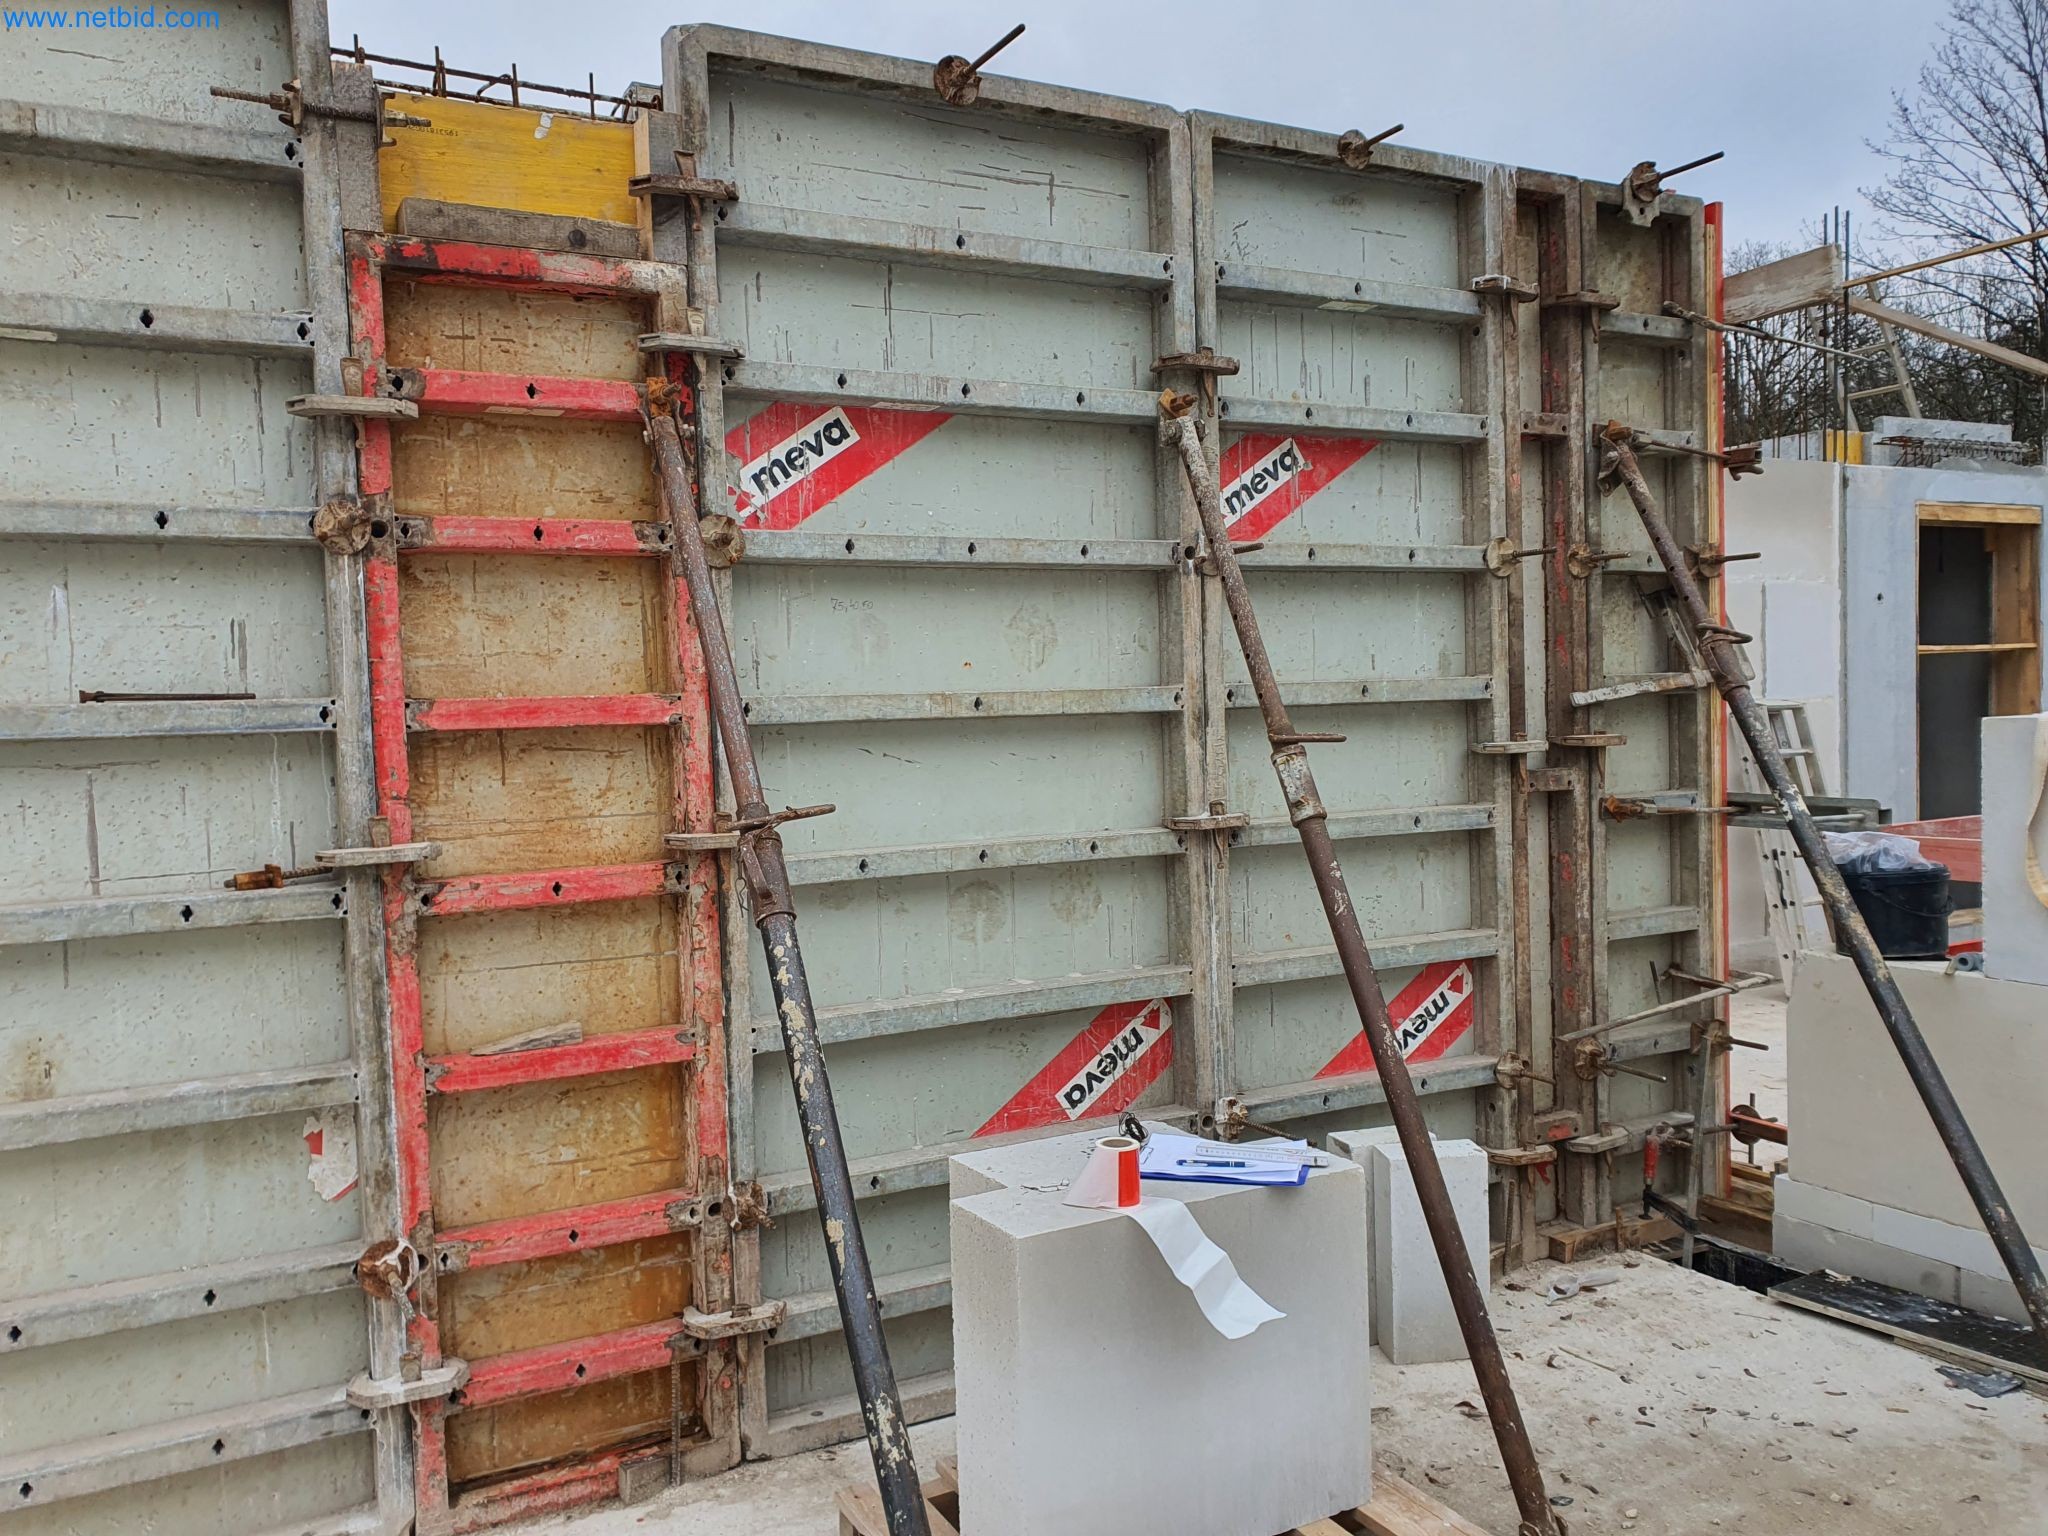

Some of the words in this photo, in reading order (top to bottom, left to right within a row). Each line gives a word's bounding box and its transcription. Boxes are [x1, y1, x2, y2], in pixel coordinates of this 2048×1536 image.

[750, 416, 851, 496] meva
[1224, 446, 1299, 516] meva
[1396, 990, 1450, 1052] mev
[1063, 1026, 1145, 1110] meva
